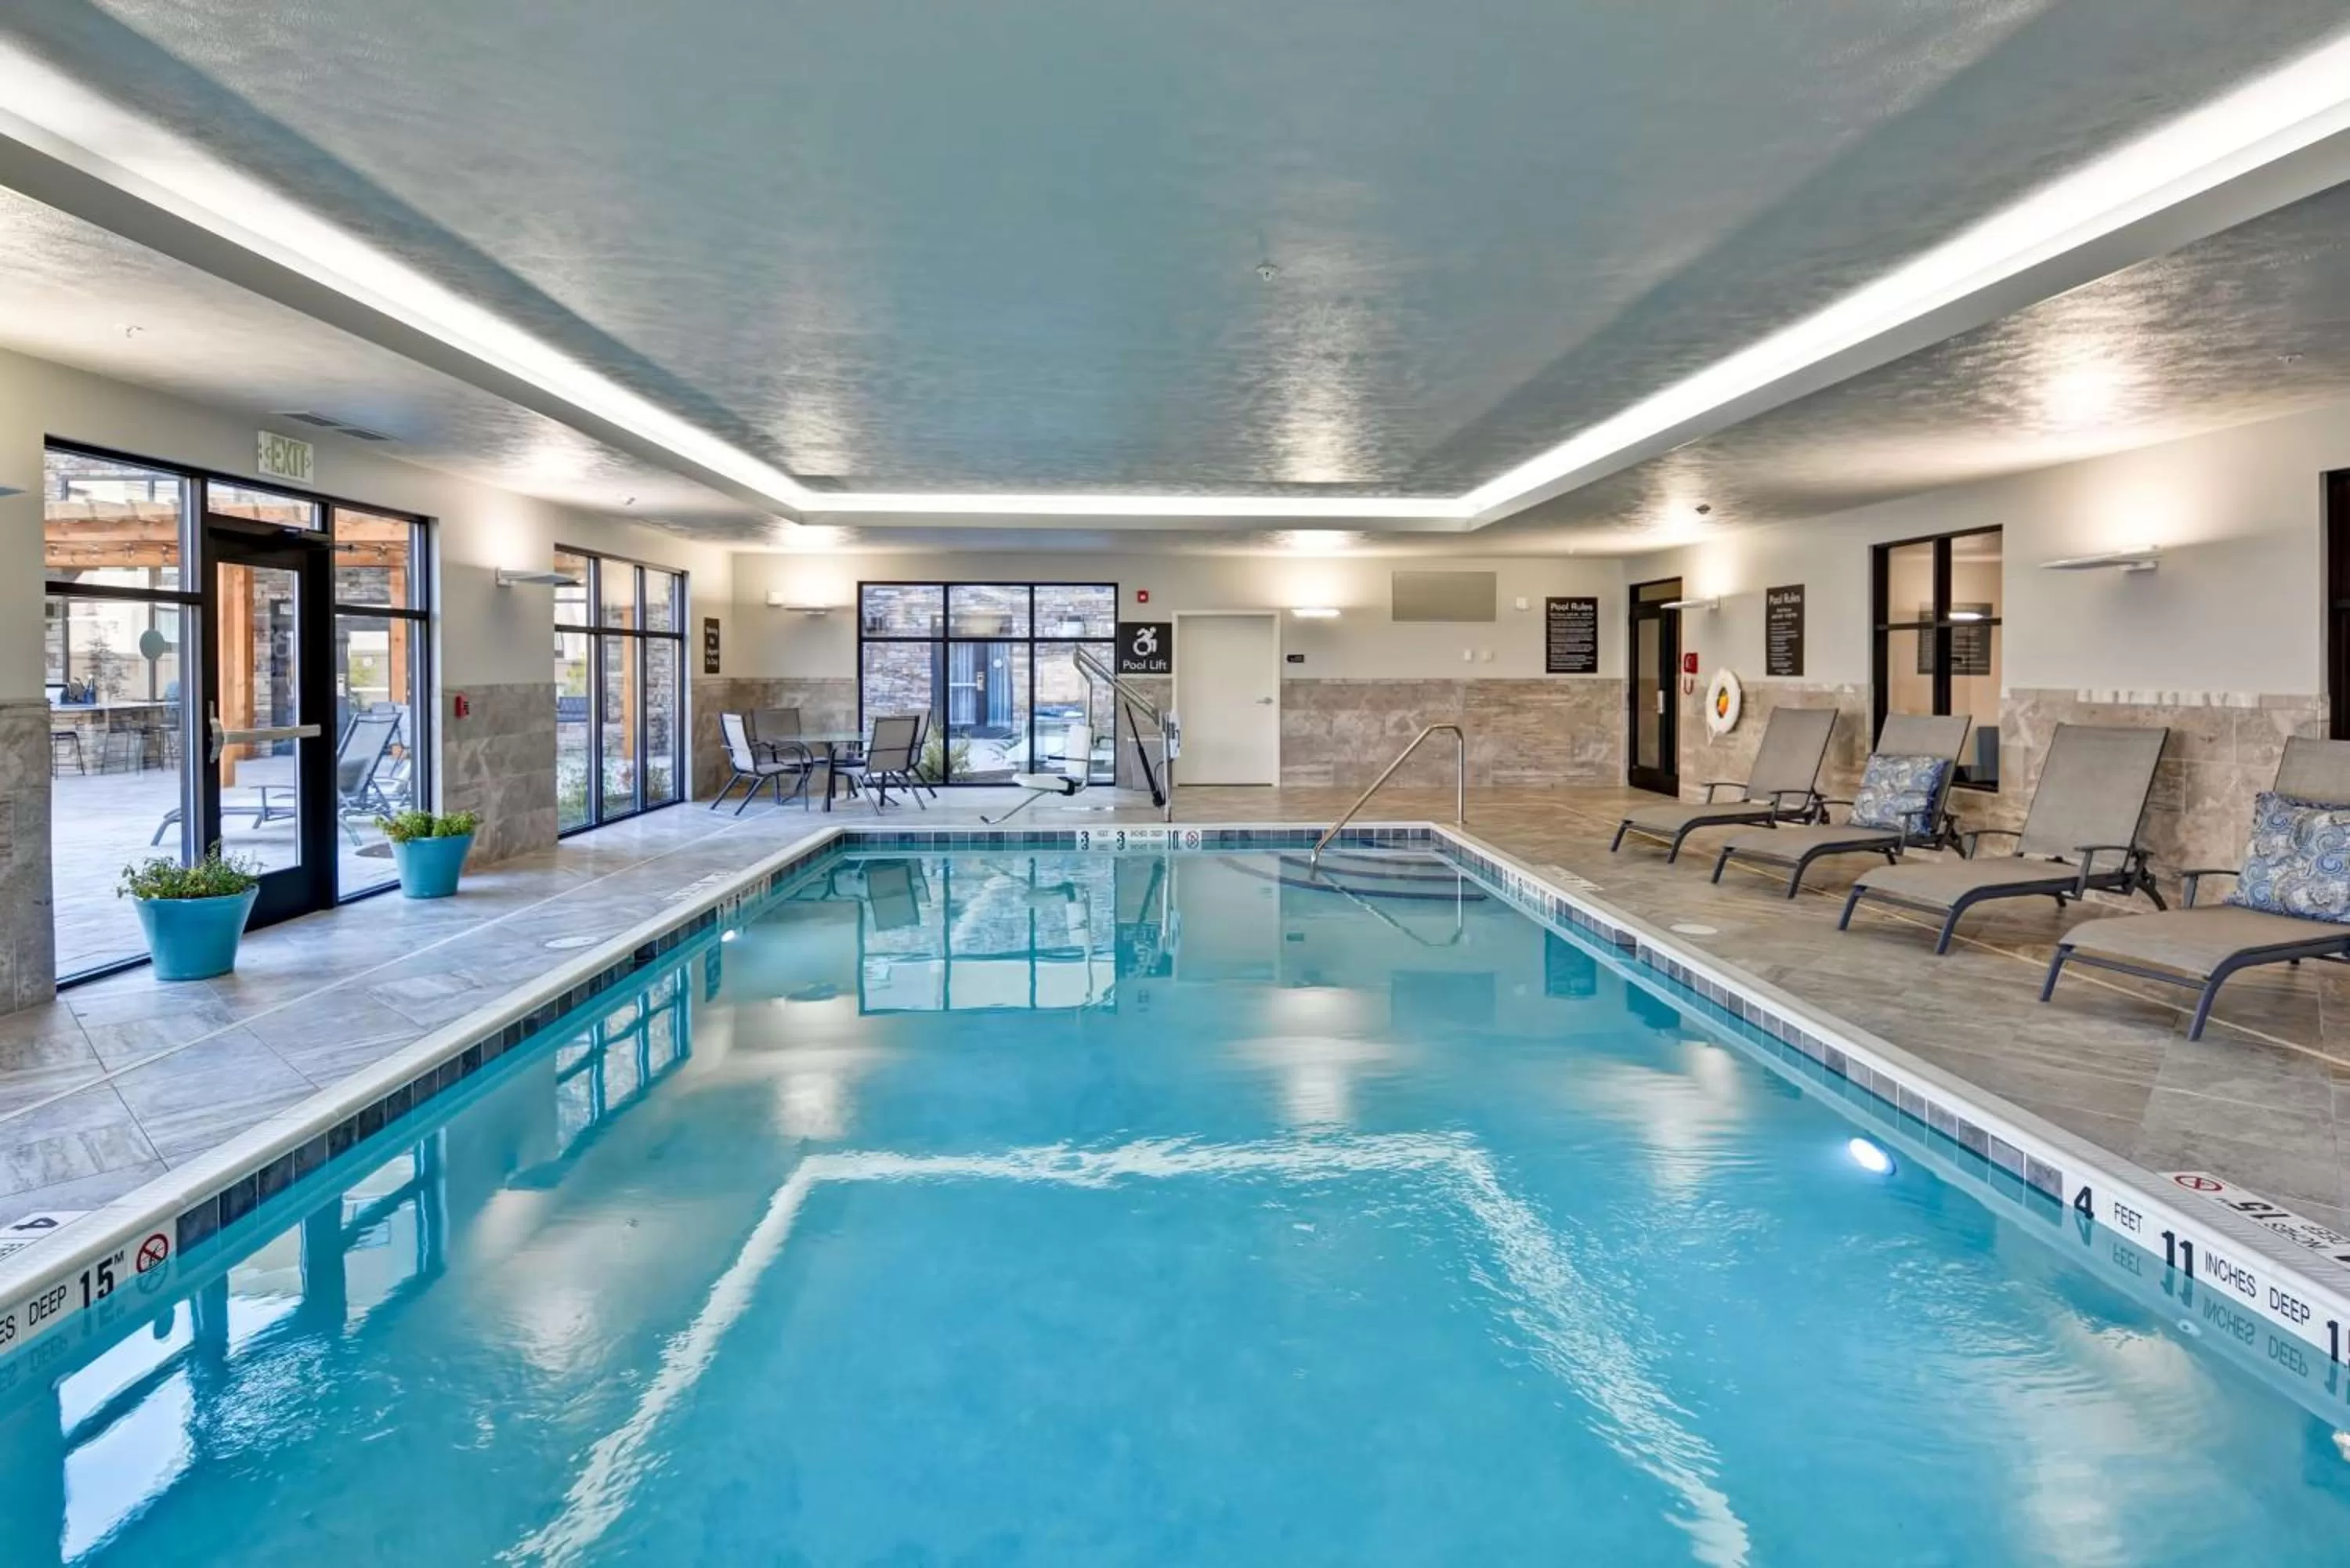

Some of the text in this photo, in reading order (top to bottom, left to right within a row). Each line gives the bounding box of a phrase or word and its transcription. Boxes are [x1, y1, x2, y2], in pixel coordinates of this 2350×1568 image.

[271, 437, 307, 478] EXIT
[1550, 602, 1593, 611] Pool Rules
[1123, 659, 1166, 670] Pool Lift
[2074, 1186, 2094, 1219] 4
[2114, 1202, 2142, 1234] FEET
[2162, 1230, 2193, 1280] 11
[2205, 1251, 2257, 1299] INCHES
[2269, 1287, 2310, 1326] DEEP
[29, 1284, 67, 1327] DEEP
